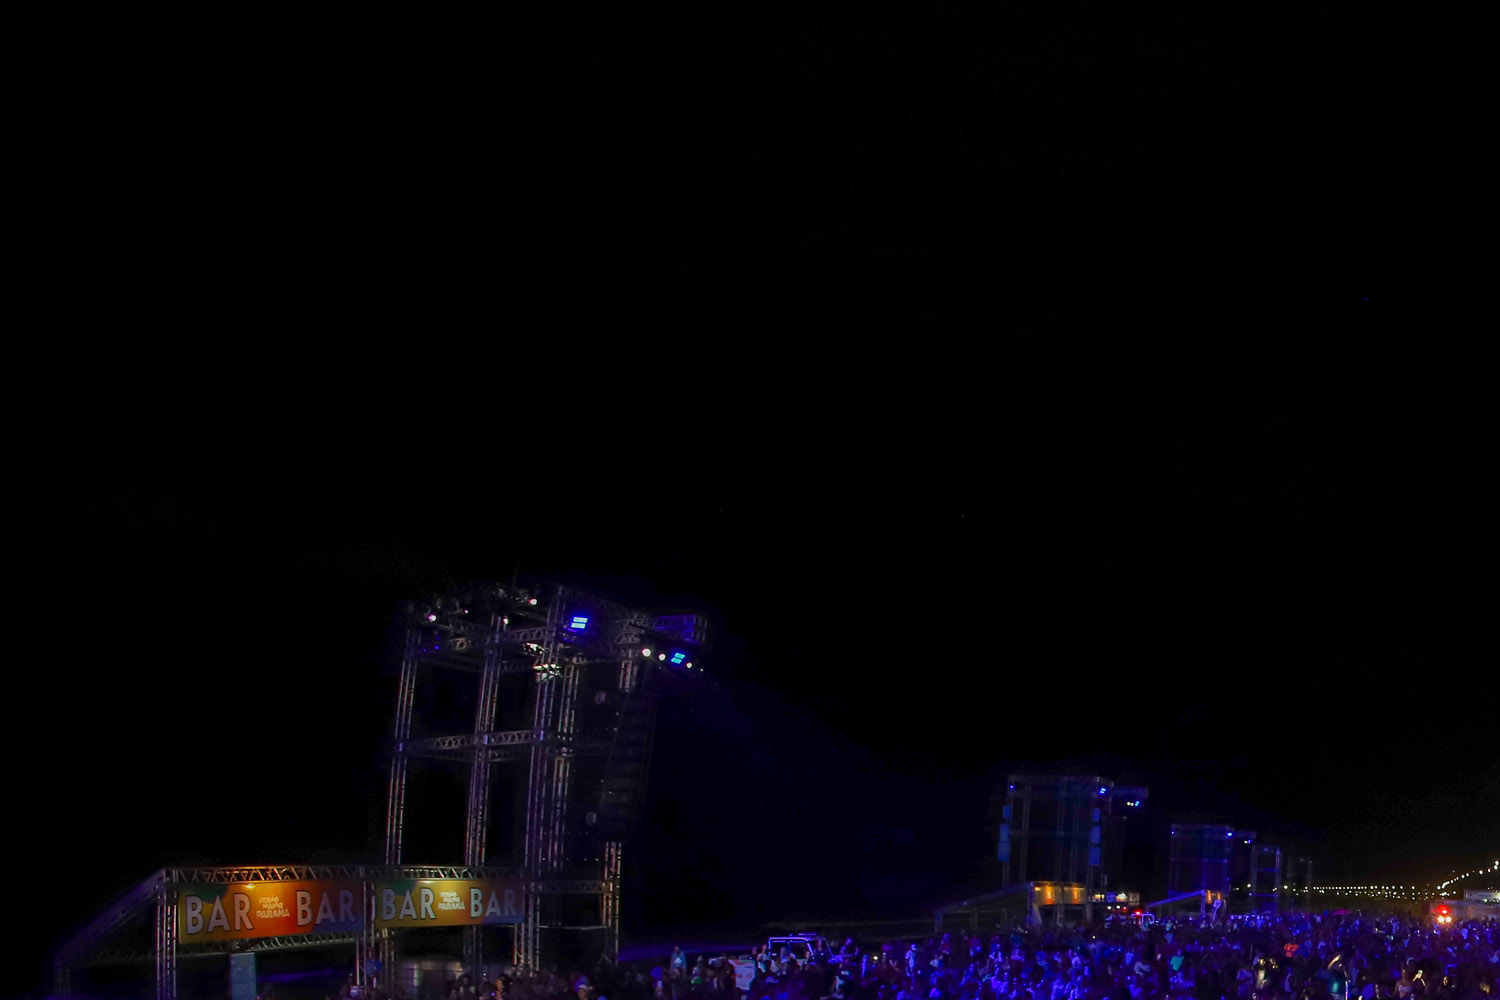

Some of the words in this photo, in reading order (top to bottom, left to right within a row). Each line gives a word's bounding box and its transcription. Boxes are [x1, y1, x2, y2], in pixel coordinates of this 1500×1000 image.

[186, 893, 254, 935] BAR
[256, 907, 290, 919] PARANÁ
[296, 889, 356, 926] BAR
[381, 887, 436, 921] BAR
[470, 887, 517, 918] BAR
